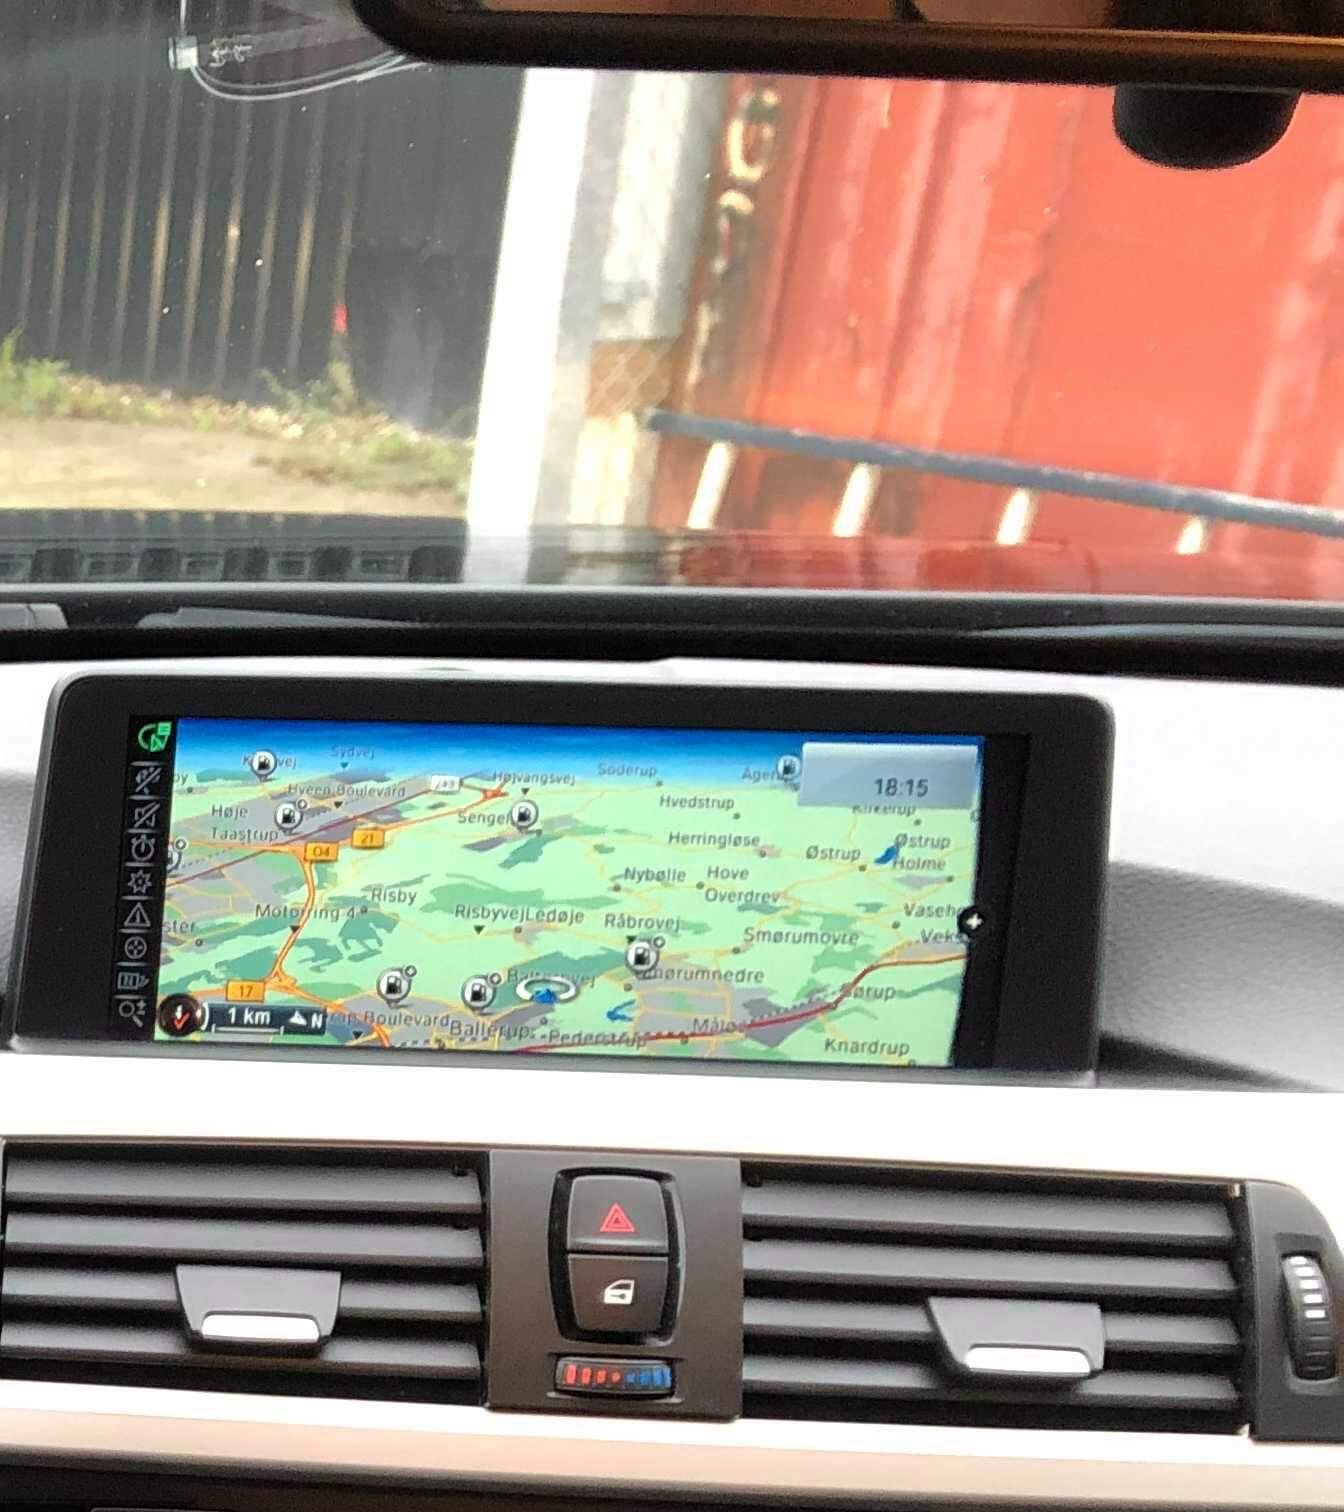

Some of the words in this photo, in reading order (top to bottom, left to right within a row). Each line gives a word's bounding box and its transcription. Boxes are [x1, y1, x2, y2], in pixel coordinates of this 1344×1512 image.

[874, 777, 929, 798] 18:15
[211, 804, 249, 820] Høje
[659, 795, 735, 812] Hvedstrup
[668, 832, 761, 849] Herringløse
[707, 865, 749, 880] Hove
[371, 887, 418, 906] Risby
[705, 887, 781, 903] Overdrev
[228, 1007, 236, 1025] 1
[244, 1008, 271, 1025] km
[825, 1038, 911, 1057] Knardrup
